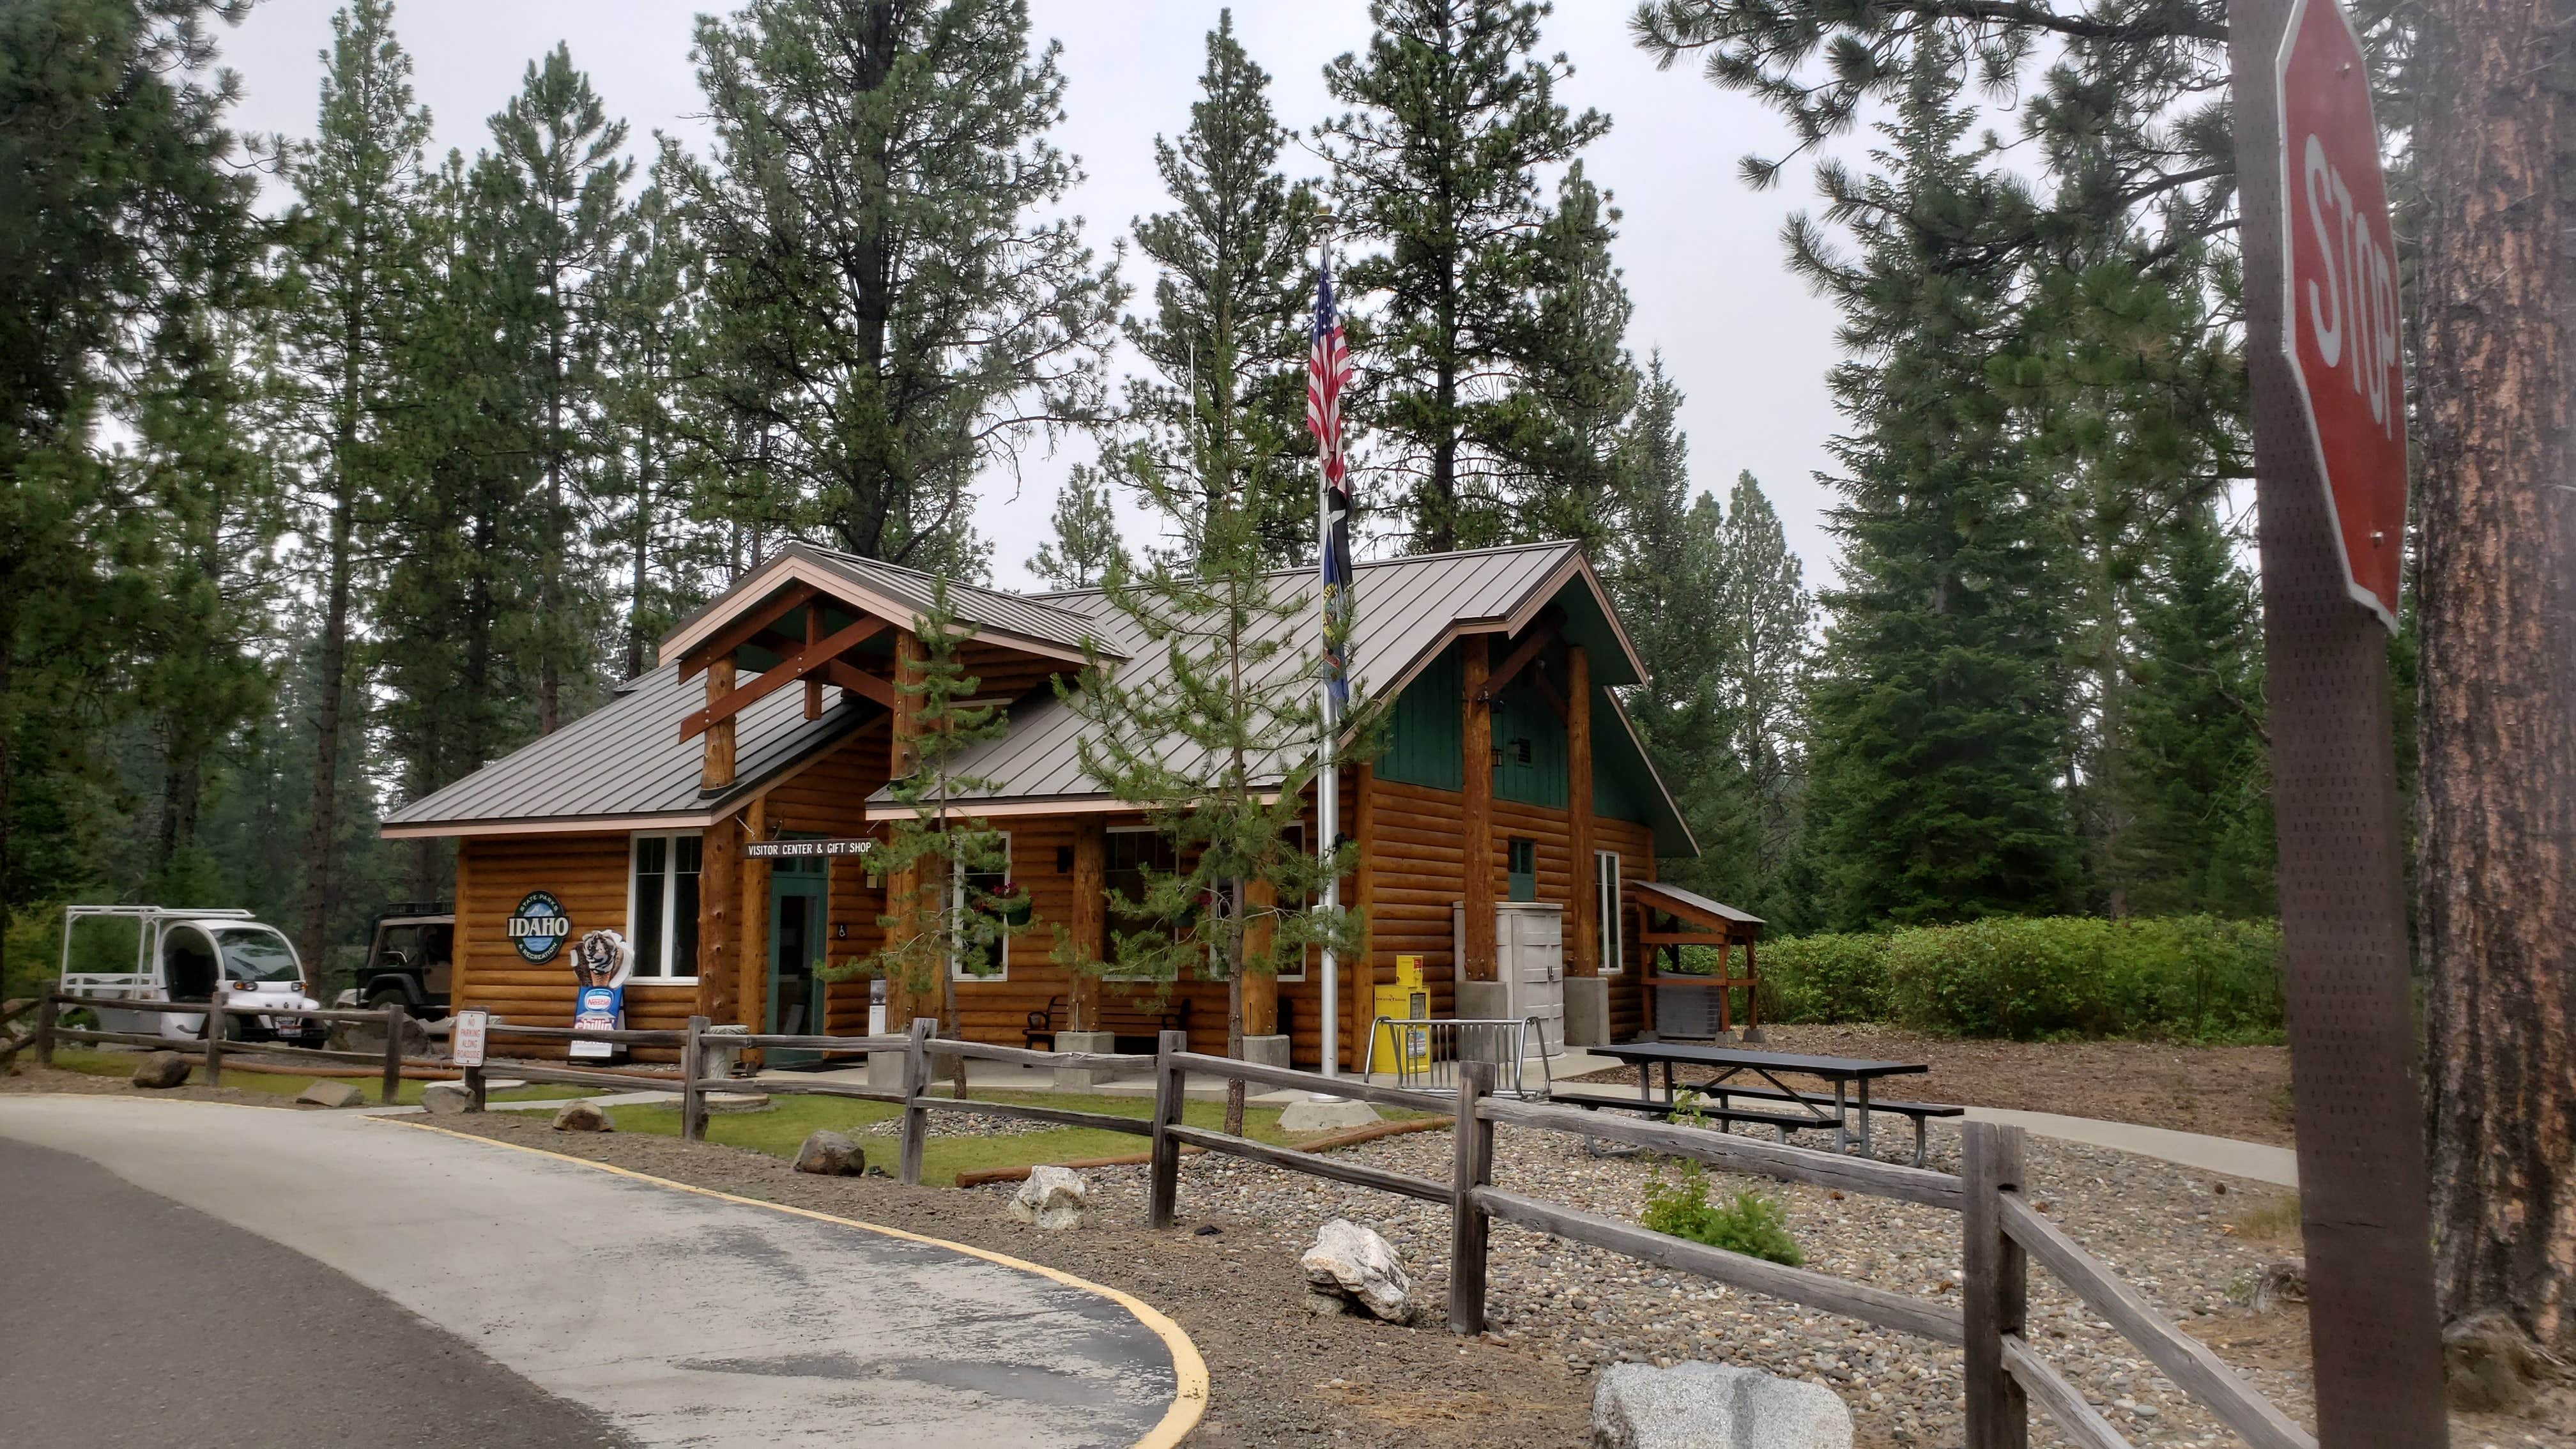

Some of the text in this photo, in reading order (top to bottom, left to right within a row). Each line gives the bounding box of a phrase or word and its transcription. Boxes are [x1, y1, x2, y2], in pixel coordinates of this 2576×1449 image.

[2304, 133, 2396, 441] STOP
[748, 841, 871, 856] VISITOR CENTER & GIFT SHOP
[520, 894, 558, 912] STATE PARKS
[508, 917, 569, 937] IDAHO
[523, 942, 558, 960] RECREATION
[467, 1016, 475, 1027] NO
[461, 1029, 480, 1038] PARKING
[461, 1039, 478, 1048] ALONG
